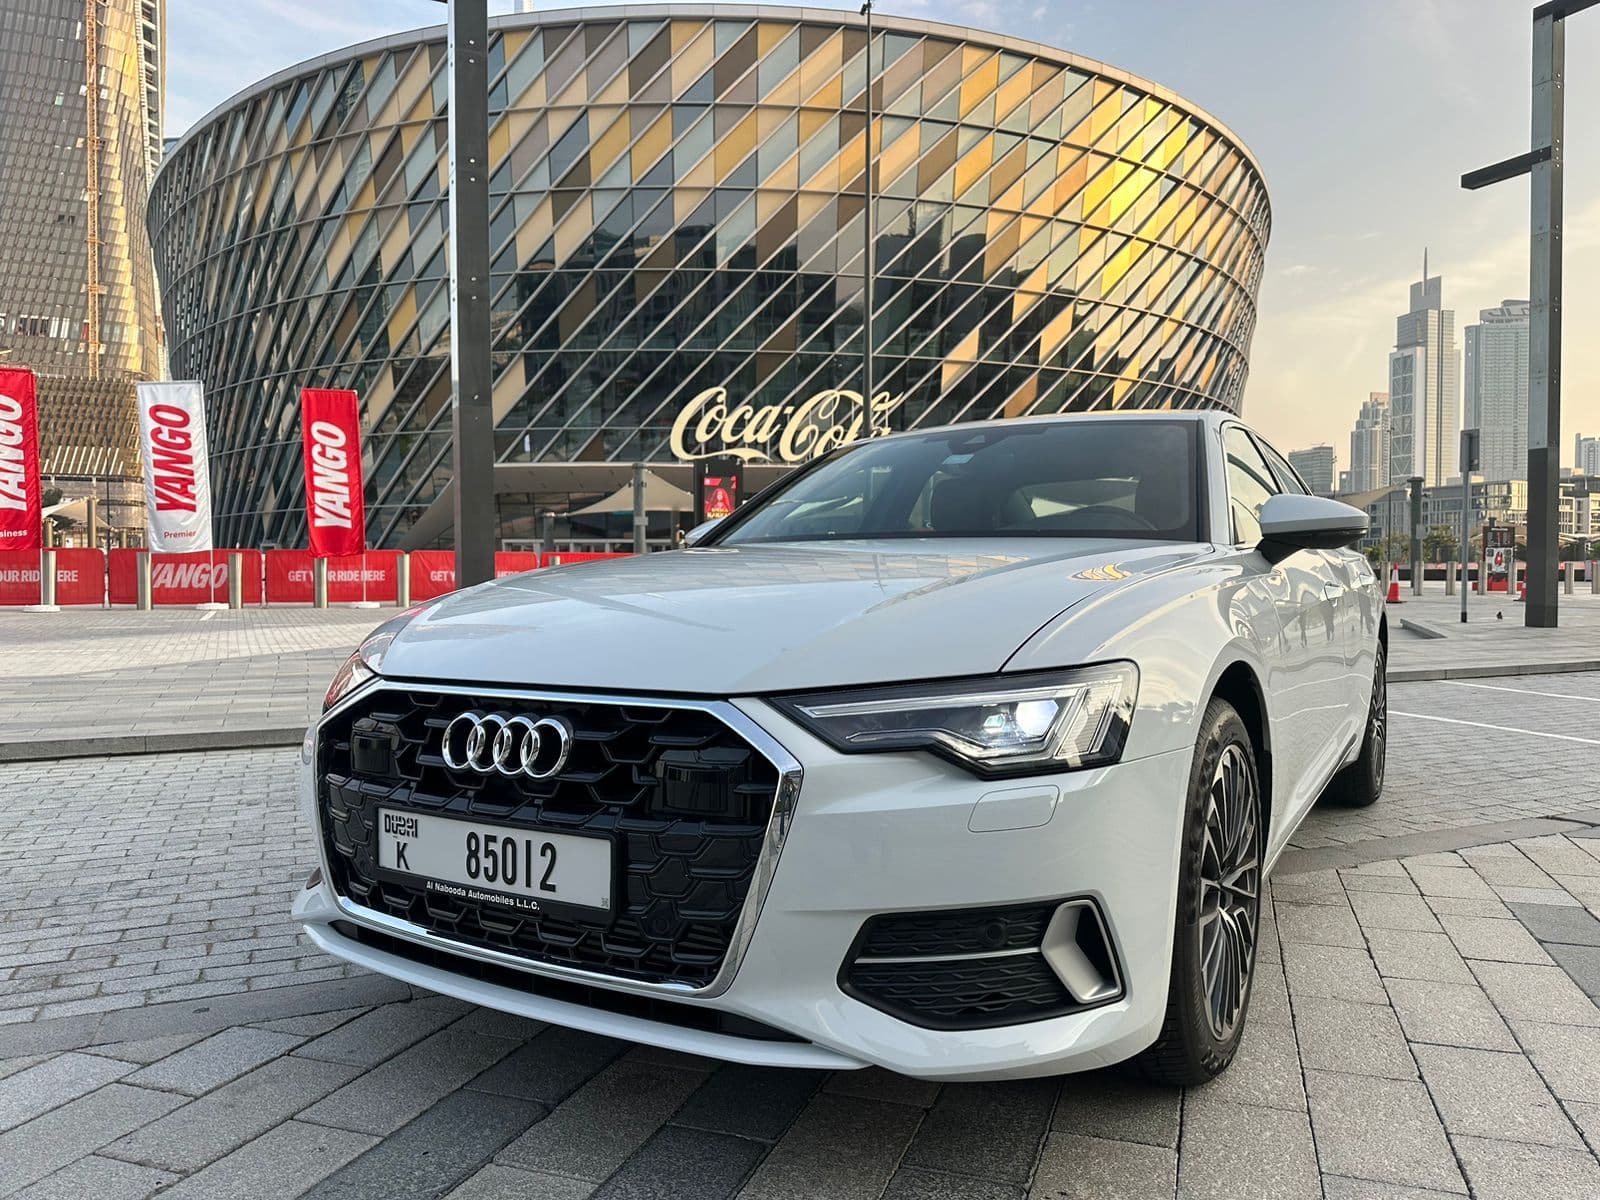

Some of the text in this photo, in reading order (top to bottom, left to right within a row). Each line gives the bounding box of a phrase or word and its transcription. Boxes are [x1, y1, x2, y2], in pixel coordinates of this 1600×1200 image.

[670, 386, 904, 462] Coca-Col
[149, 404, 197, 513] YANGO
[311, 421, 352, 528] YANGO
[0, 530, 28, 538] siness
[21, 570, 40, 582] RID
[57, 570, 78, 582] ERE
[288, 570, 306, 582] GET
[337, 570, 359, 582] RIDE
[430, 570, 447, 582] GET
[396, 831, 557, 893] K 85012
[426, 880, 540, 911] Al Nabooda Automobiles L.L.C.
